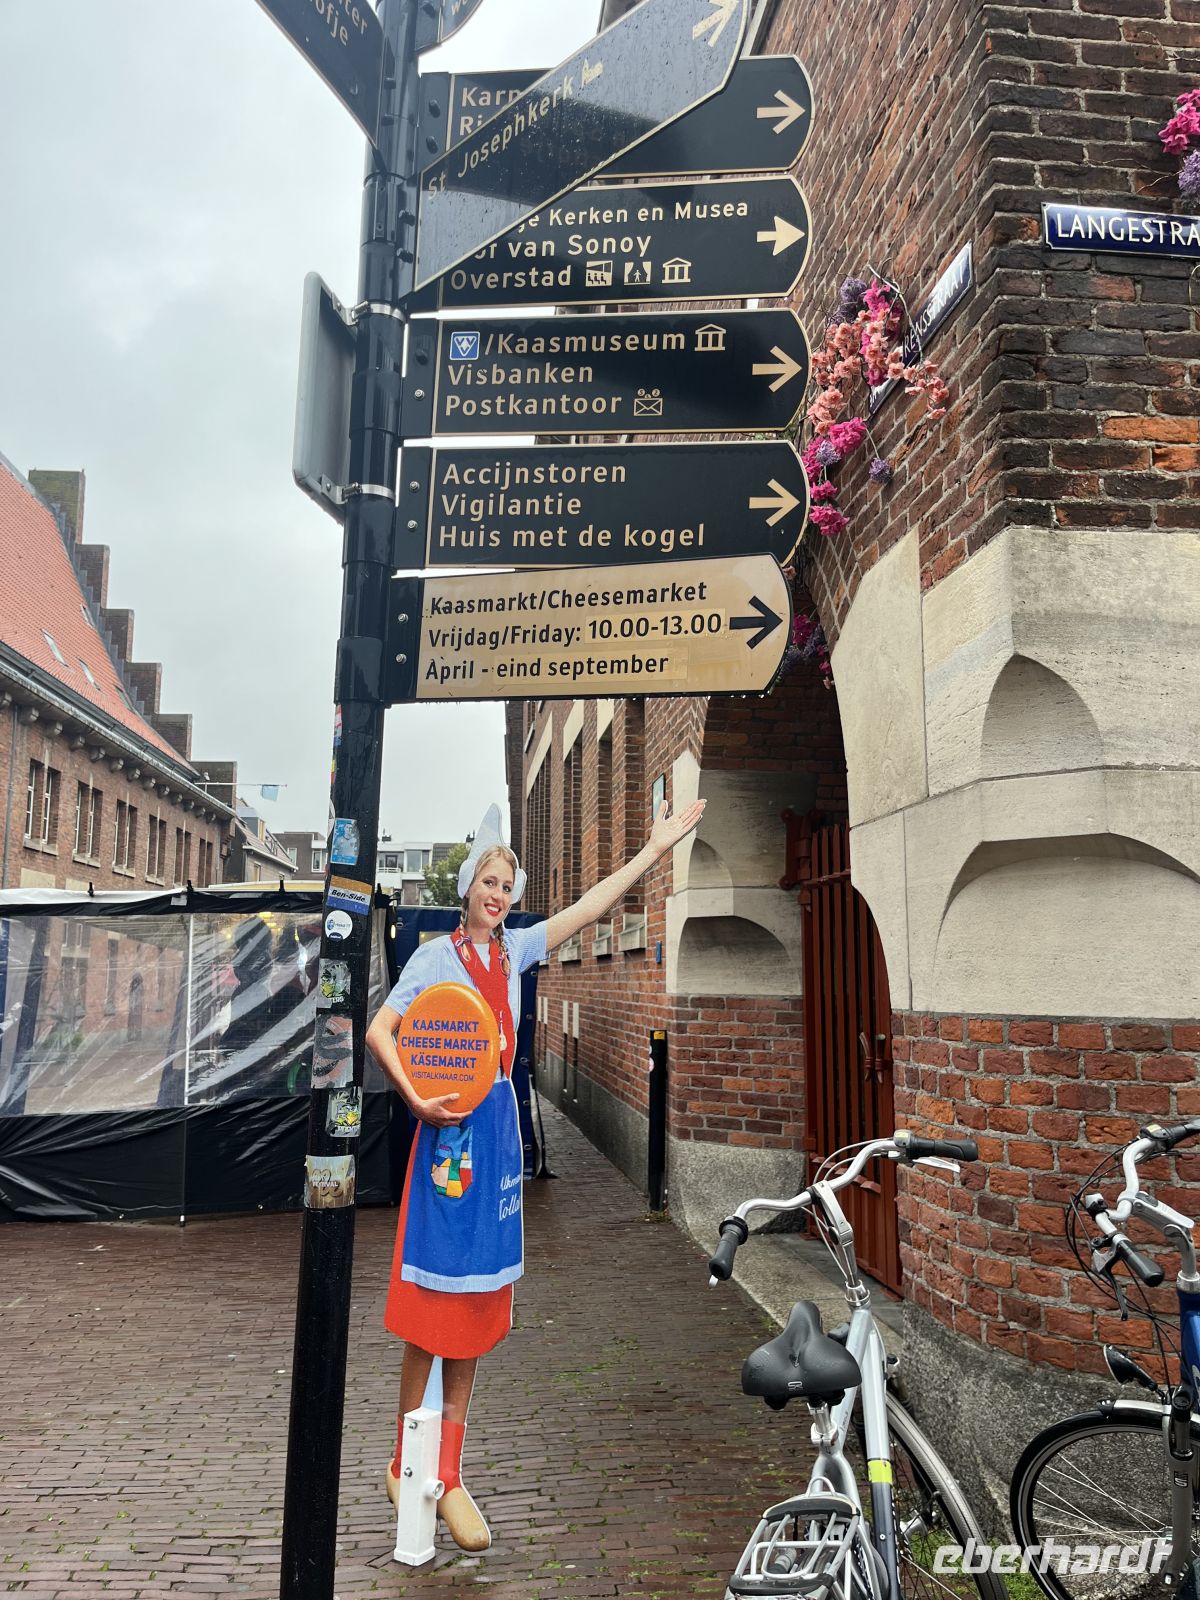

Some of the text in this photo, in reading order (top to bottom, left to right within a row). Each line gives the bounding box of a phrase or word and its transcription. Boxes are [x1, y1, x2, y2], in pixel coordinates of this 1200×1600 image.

[428, 74, 574, 200] St Josephkerk
[550, 206, 629, 227] Kerken
[637, 206, 664, 222] en
[674, 201, 748, 220] Musea
[508, 239, 556, 258] van
[567, 234, 651, 258] Sonoy
[451, 264, 572, 291] Overstad
[485, 332, 686, 356] /Kaasmuseum
[448, 362, 593, 386] Visbanken
[445, 394, 623, 417] Postkantoor
[442, 461, 627, 490] Accijnstoren
[441, 492, 583, 522] Vigilantie
[439, 522, 705, 553] Huis met de kogel
[430, 581, 707, 616] Kaasmarkt/Cheesemarket
[428, 612, 723, 652] Vrijdag/Friday: 10.00-13.00
[425, 657, 475, 685] April
[496, 657, 542, 679] eind
[547, 653, 670, 682] september
[331, 889, 366, 903] Ben-Side
[412, 1019, 480, 1033] KAASMARKT
[401, 1036, 490, 1051] CHEESE MARKET
[410, 1051, 477, 1069] KÄSEMARKT
[411, 1071, 475, 1082] VISITALKMAAR.COM
